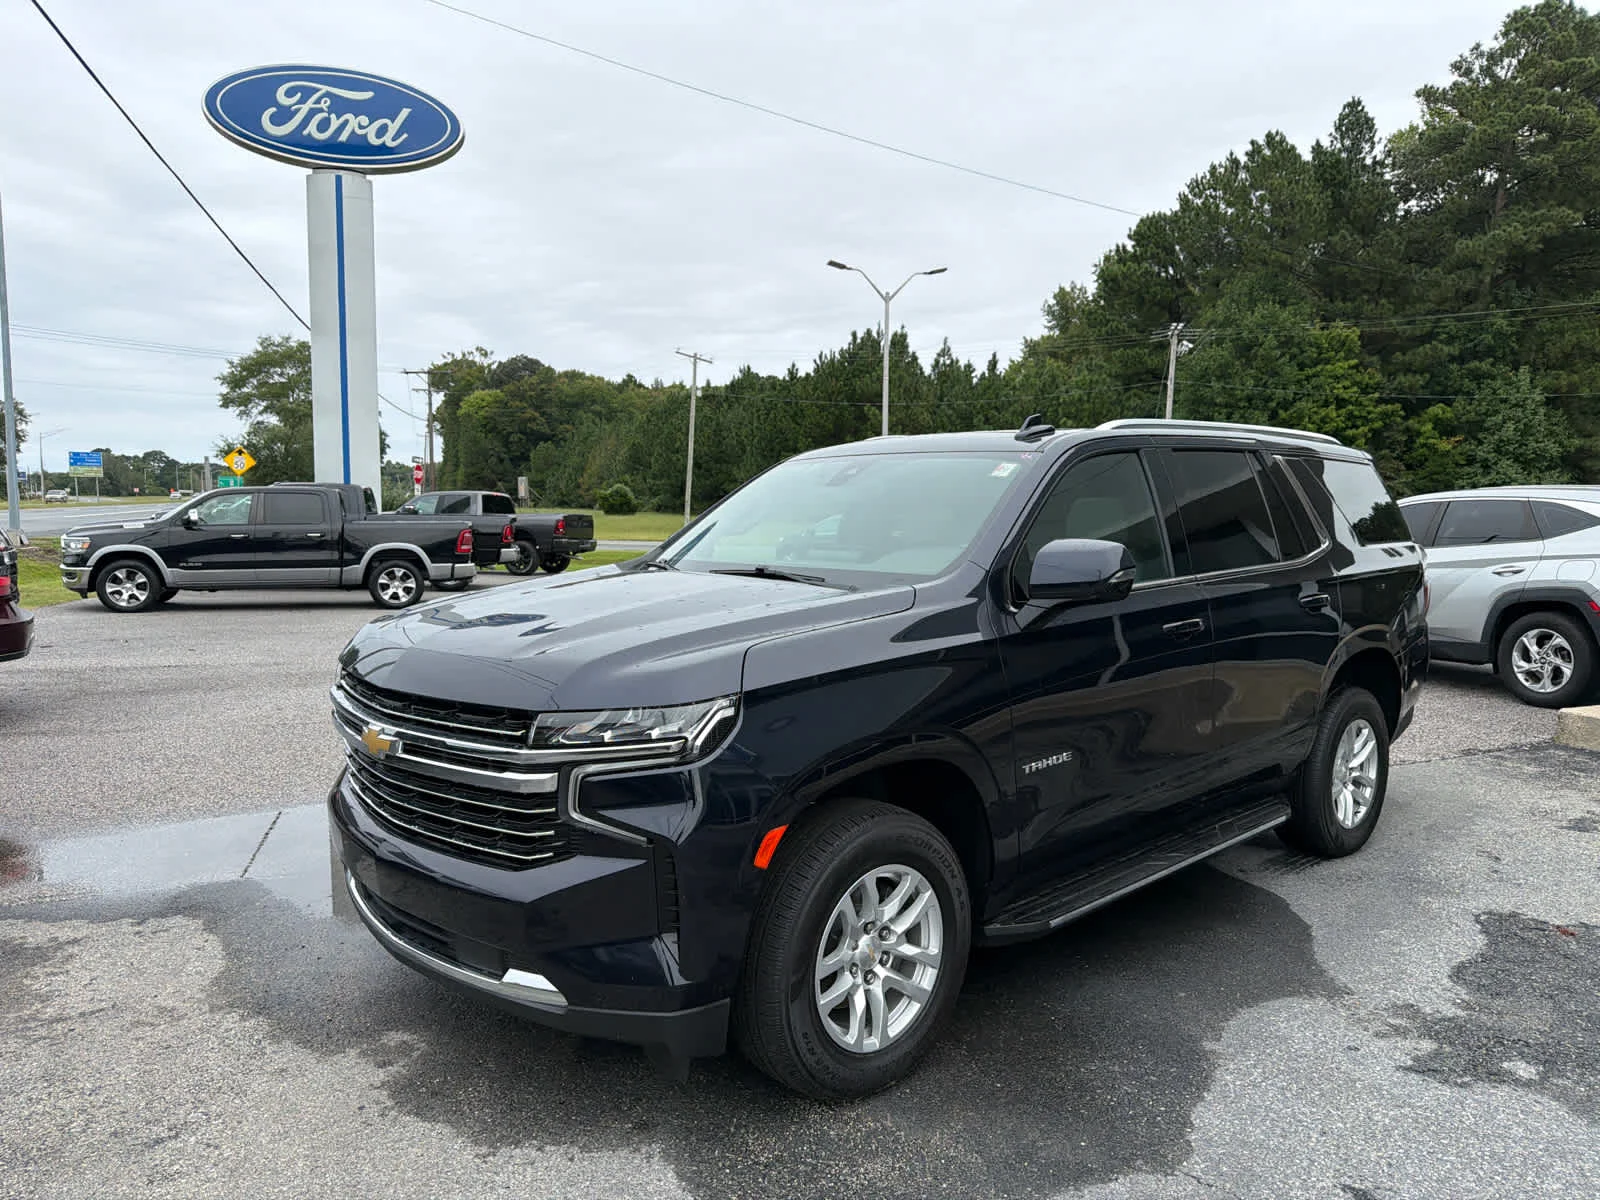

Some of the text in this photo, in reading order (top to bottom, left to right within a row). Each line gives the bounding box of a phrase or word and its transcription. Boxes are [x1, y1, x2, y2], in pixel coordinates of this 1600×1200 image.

[261, 81, 412, 147] Ford
[234, 460, 245, 469] 50
[1022, 752, 1072, 774] TAHOE
